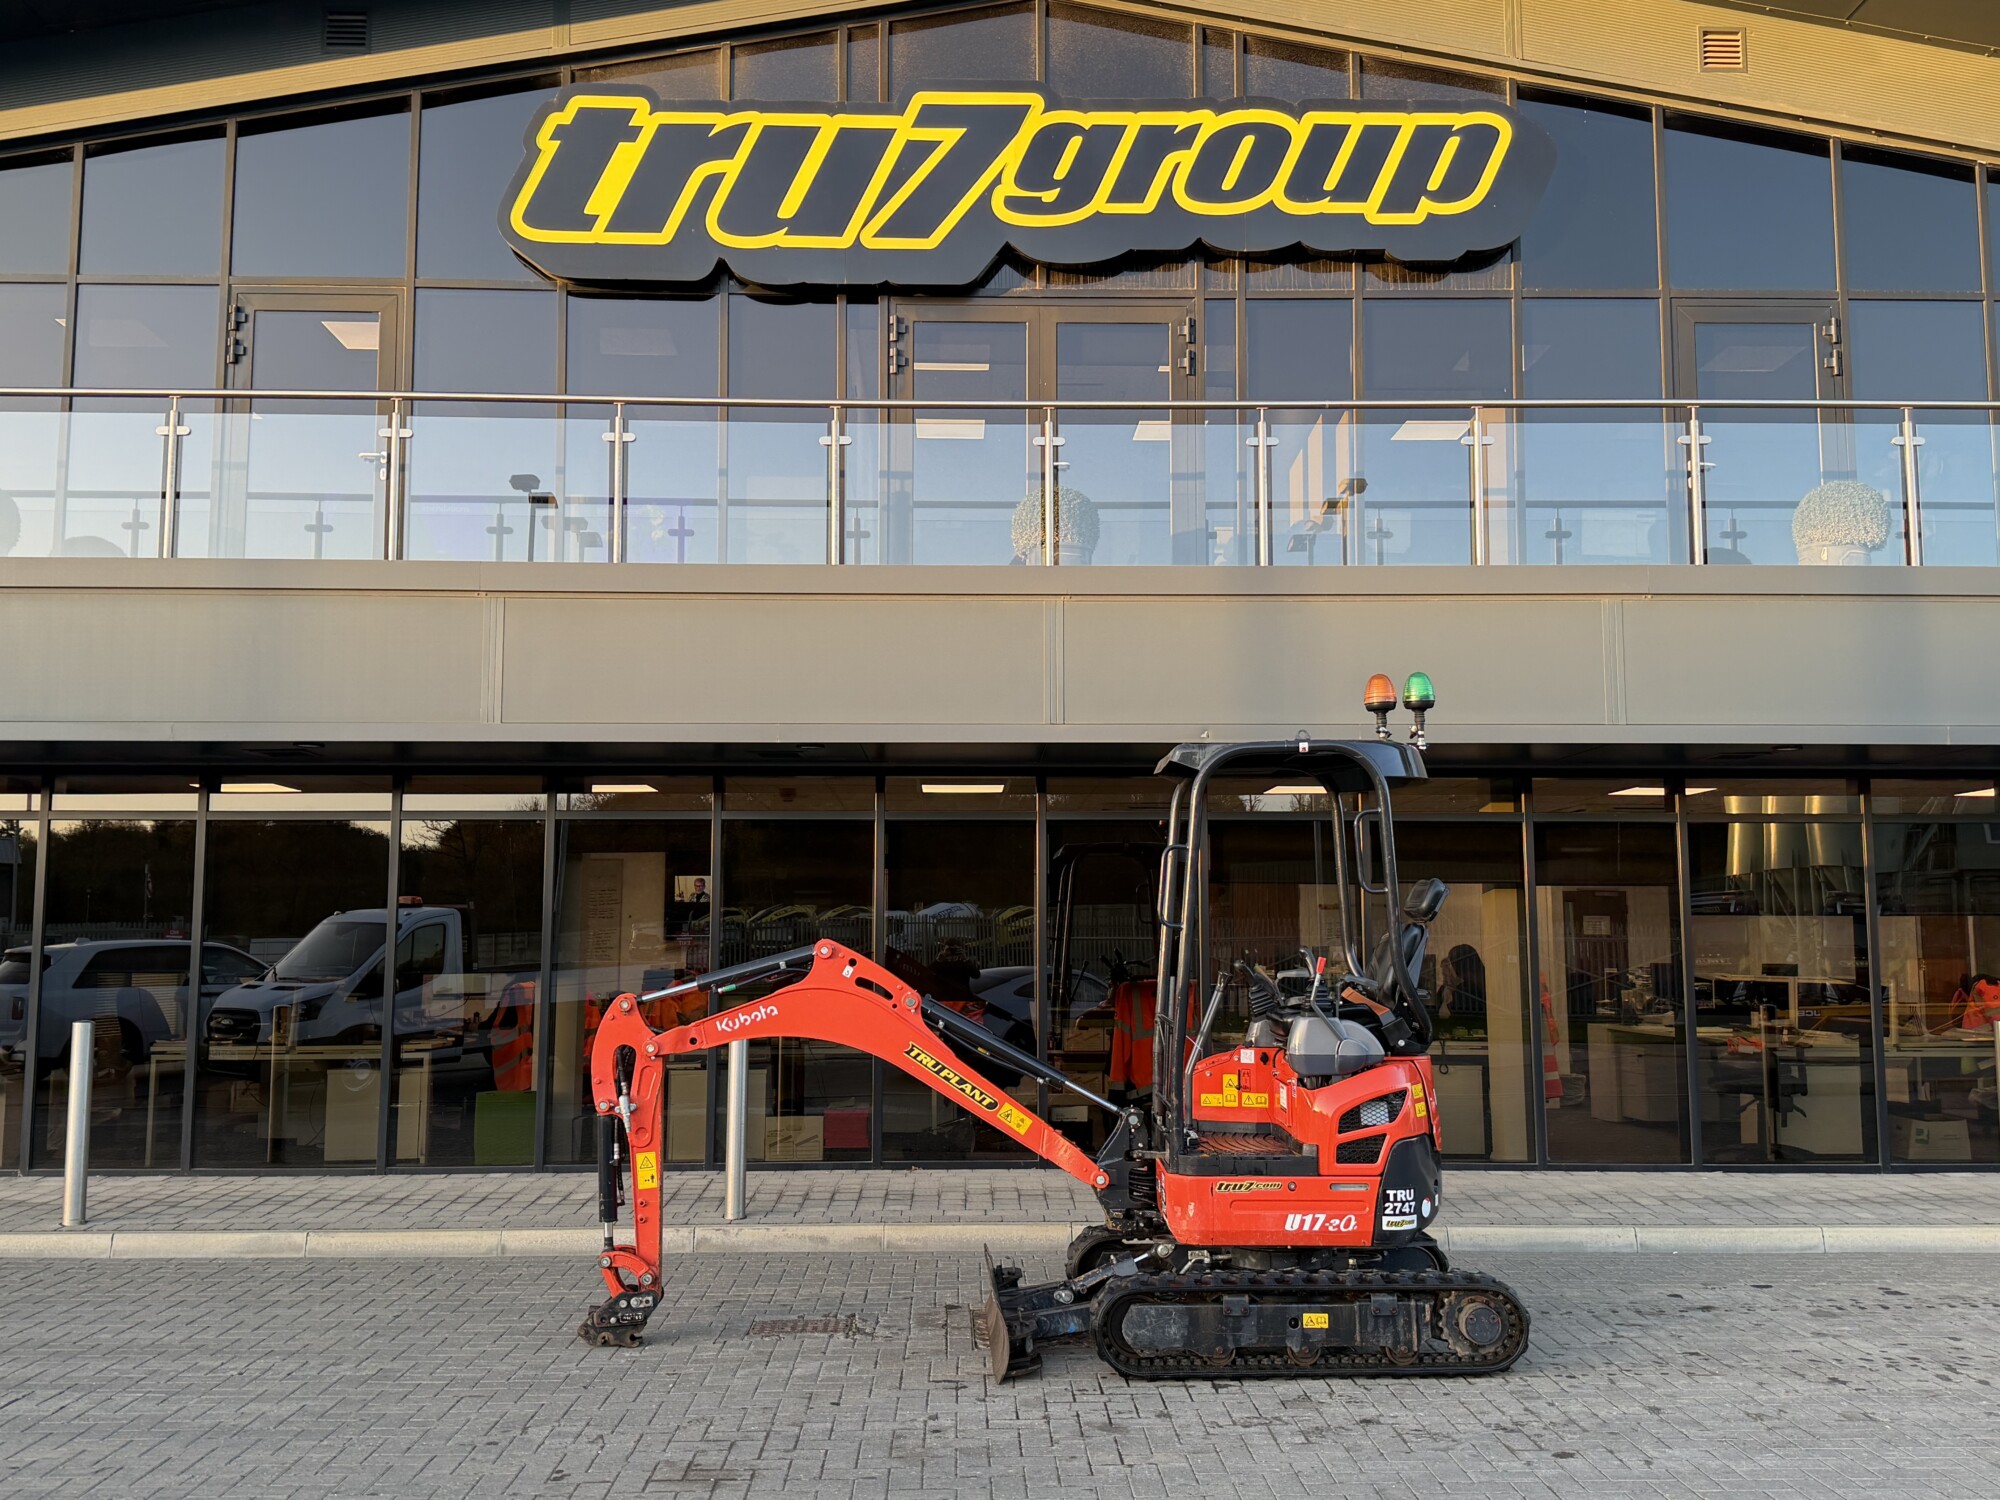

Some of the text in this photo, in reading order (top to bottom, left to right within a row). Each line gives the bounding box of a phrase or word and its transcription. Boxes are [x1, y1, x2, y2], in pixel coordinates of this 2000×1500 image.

[715, 1005, 779, 1032] Kubota
[908, 1046, 995, 1107] TRU PLANT
[1385, 1189, 1415, 1202] TRU
[1383, 1201, 1416, 1215] 2747
